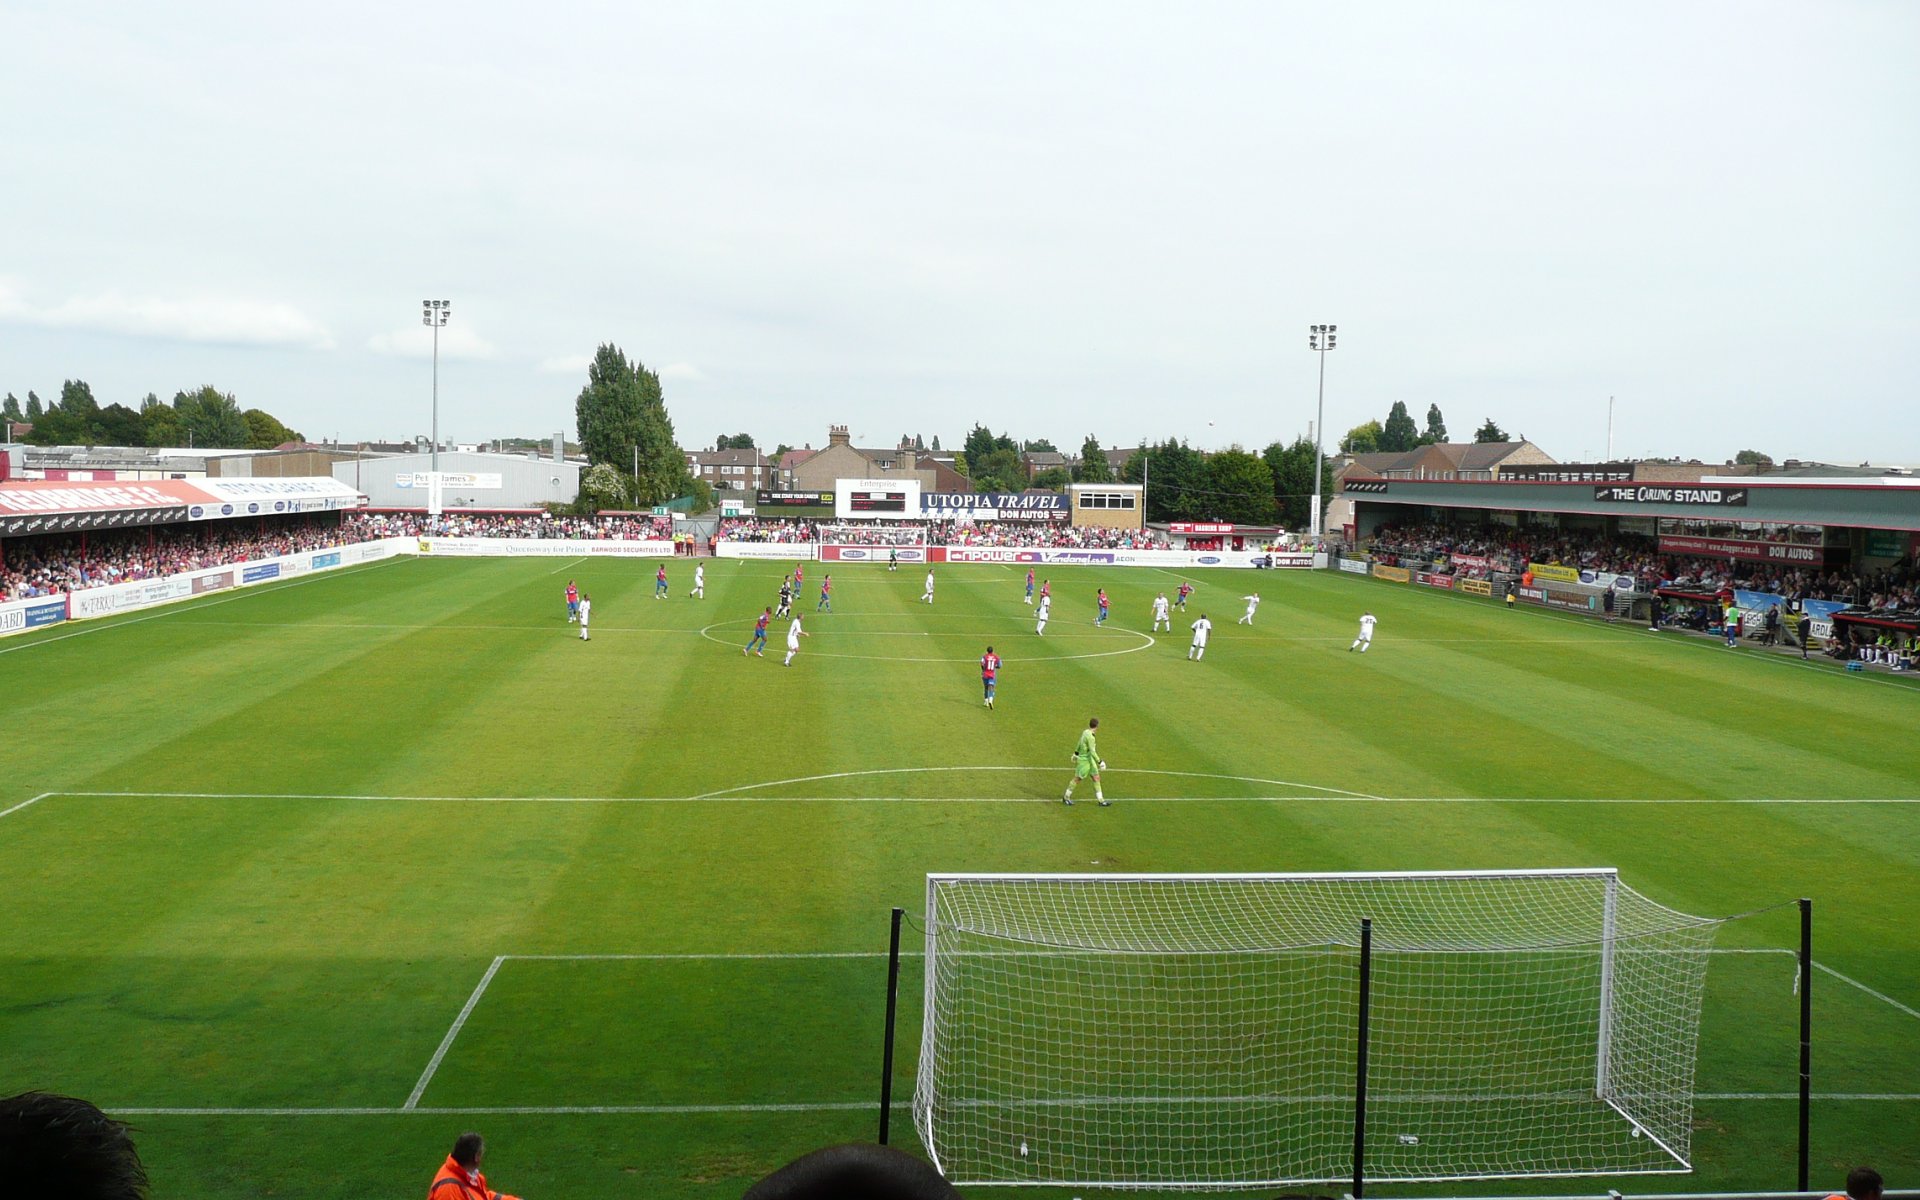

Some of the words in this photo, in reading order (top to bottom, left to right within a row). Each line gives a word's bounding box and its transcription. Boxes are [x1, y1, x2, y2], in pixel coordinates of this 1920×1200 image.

[442, 474, 466, 482] James
[860, 480, 897, 488] Enterprise
[1612, 488, 1635, 500] THE
[1674, 490, 1722, 502] STAND
[926, 494, 992, 508] UTOPIA
[997, 495, 1061, 508] TRAVEL
[1000, 510, 1020, 518] DON
[1020, 510, 1050, 519] AUTOS
[505, 545, 550, 554] Queensway
[552, 545, 564, 553] for
[1769, 546, 1786, 558] DON
[1788, 548, 1814, 560] AUTOS
